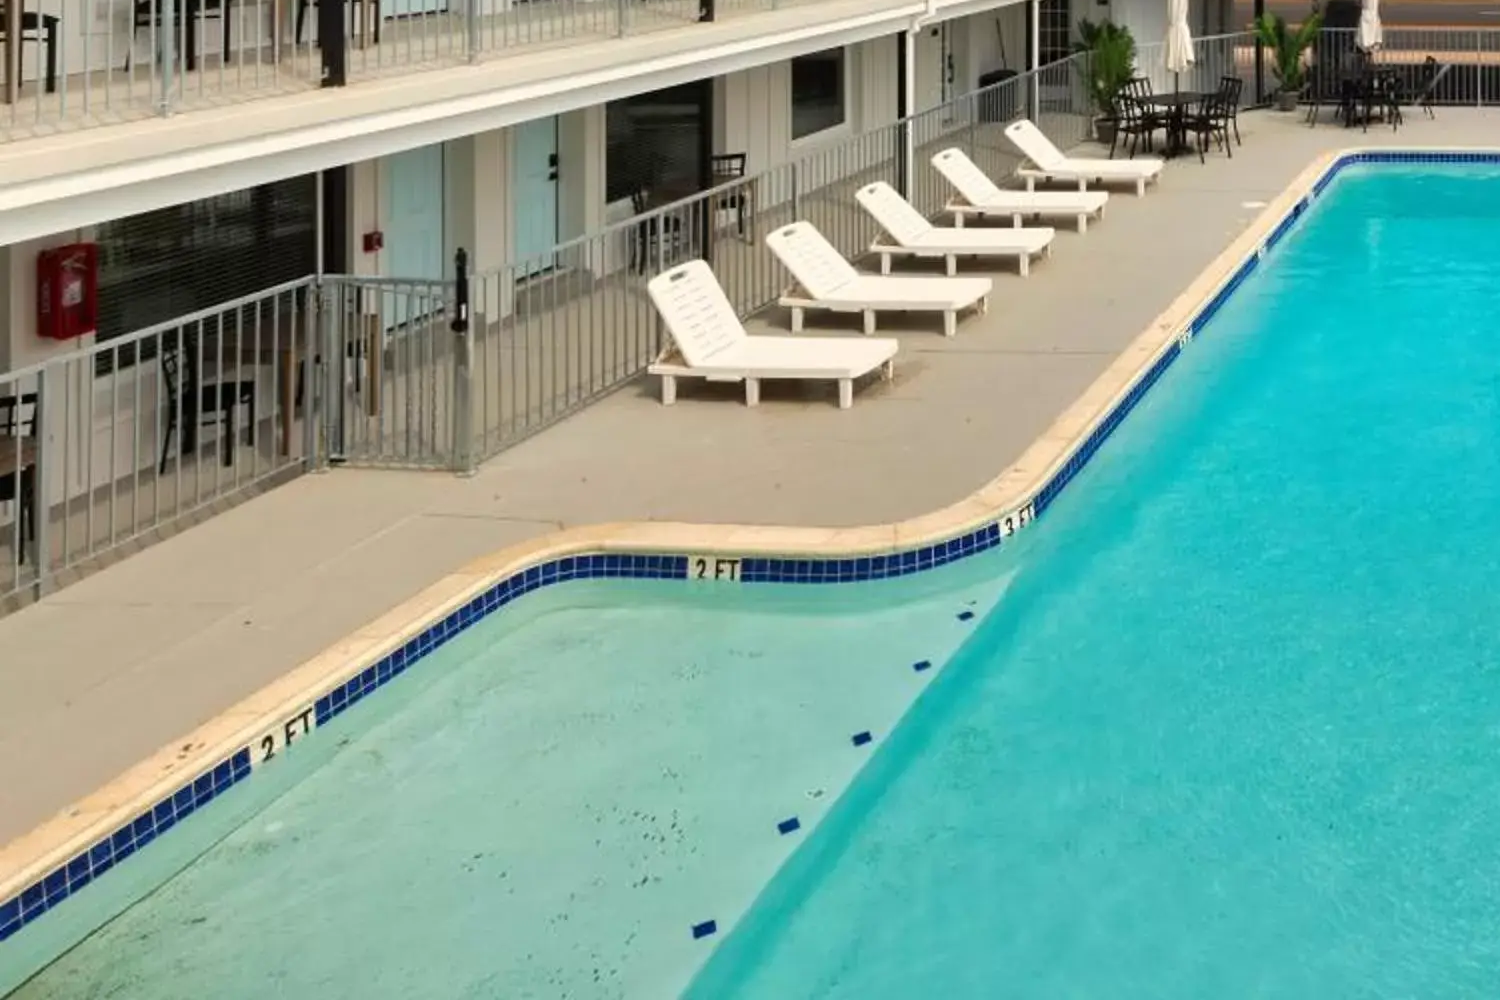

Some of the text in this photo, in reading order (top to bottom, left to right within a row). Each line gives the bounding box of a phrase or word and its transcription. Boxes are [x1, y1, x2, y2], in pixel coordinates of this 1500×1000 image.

[1005, 501, 1032, 537] 3 FT
[696, 558, 739, 580] 2 FT
[261, 707, 312, 763] 2 FT
